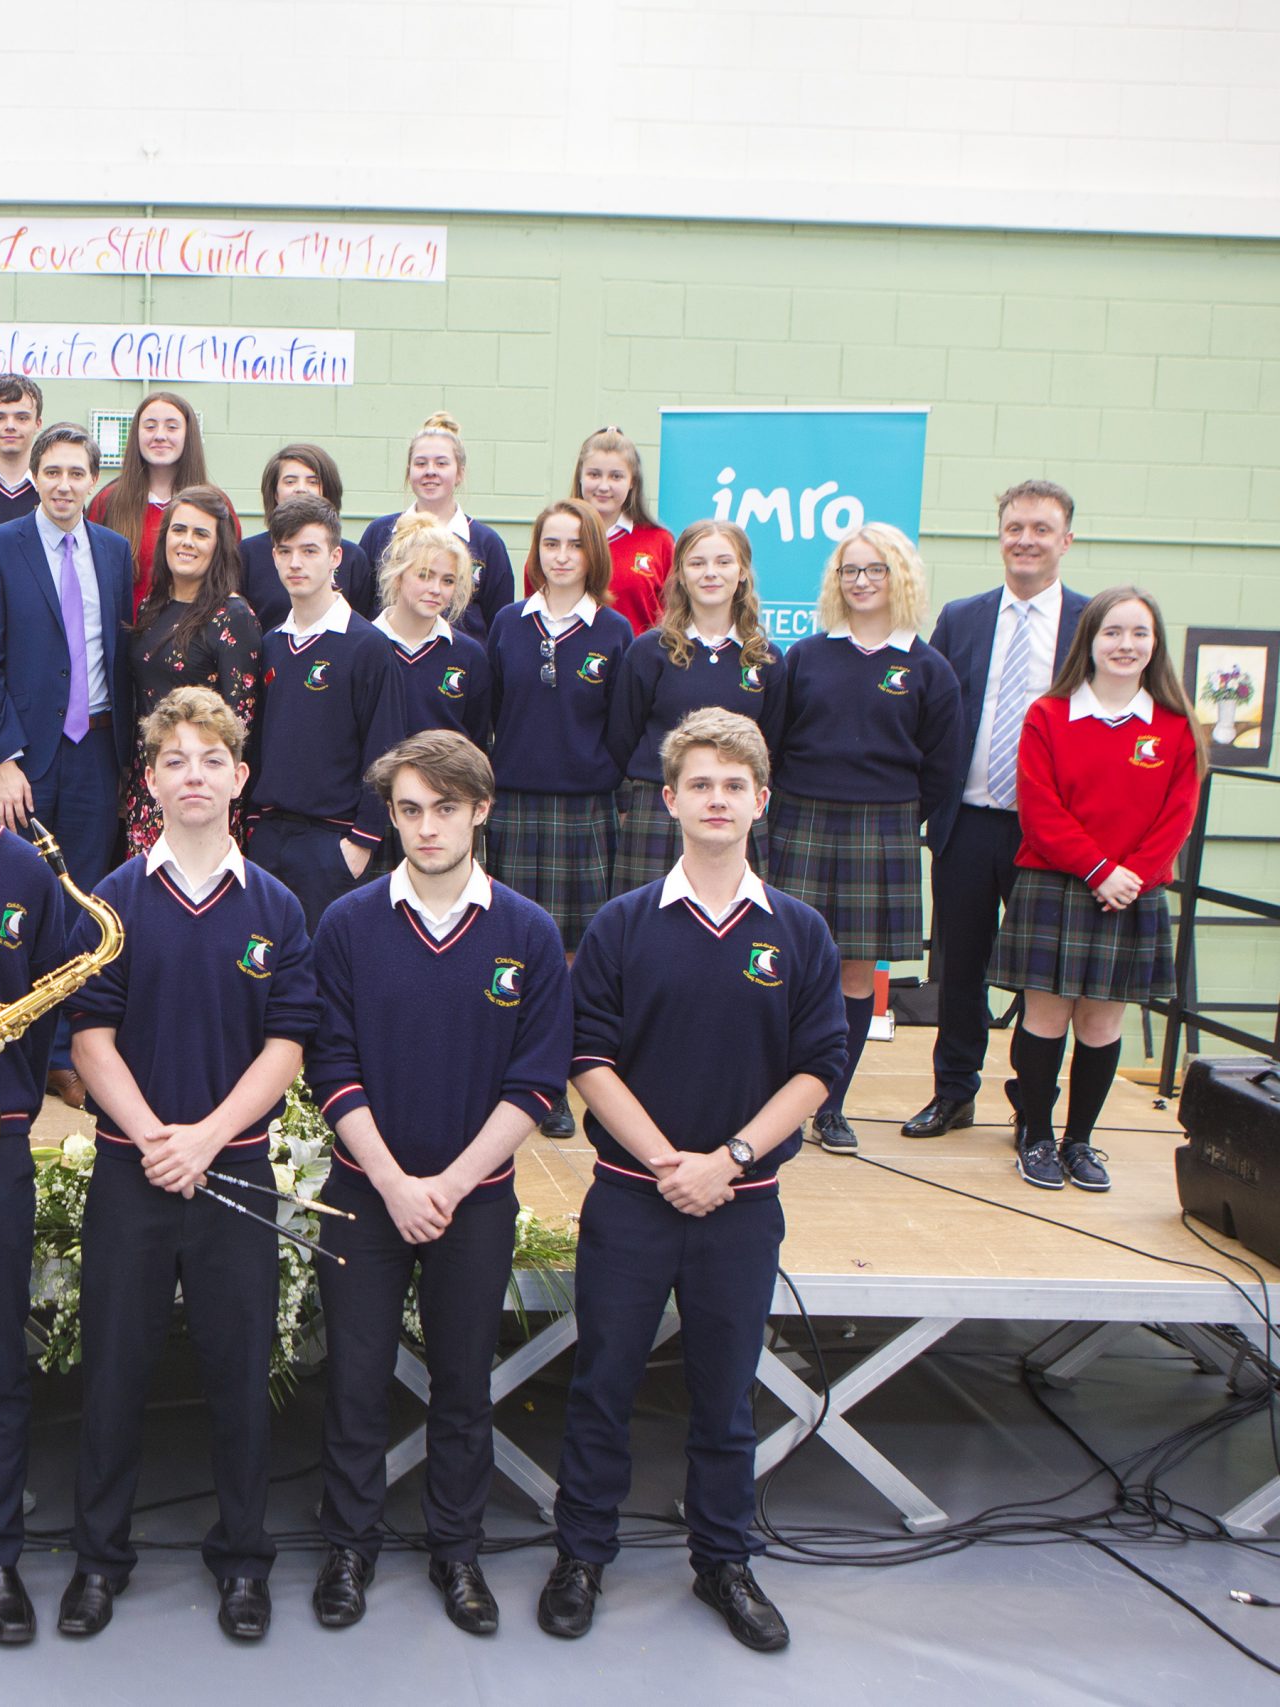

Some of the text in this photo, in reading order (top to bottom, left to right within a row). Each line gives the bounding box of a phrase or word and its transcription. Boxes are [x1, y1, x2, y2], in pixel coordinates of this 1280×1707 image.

[0, 226, 84, 271] Love
[86, 226, 170, 272] Still
[179, 227, 286, 275] Guides
[289, 232, 352, 276] My
[357, 234, 438, 278] Way
[111, 332, 186, 379] Chill
[712, 466, 864, 543] imro
